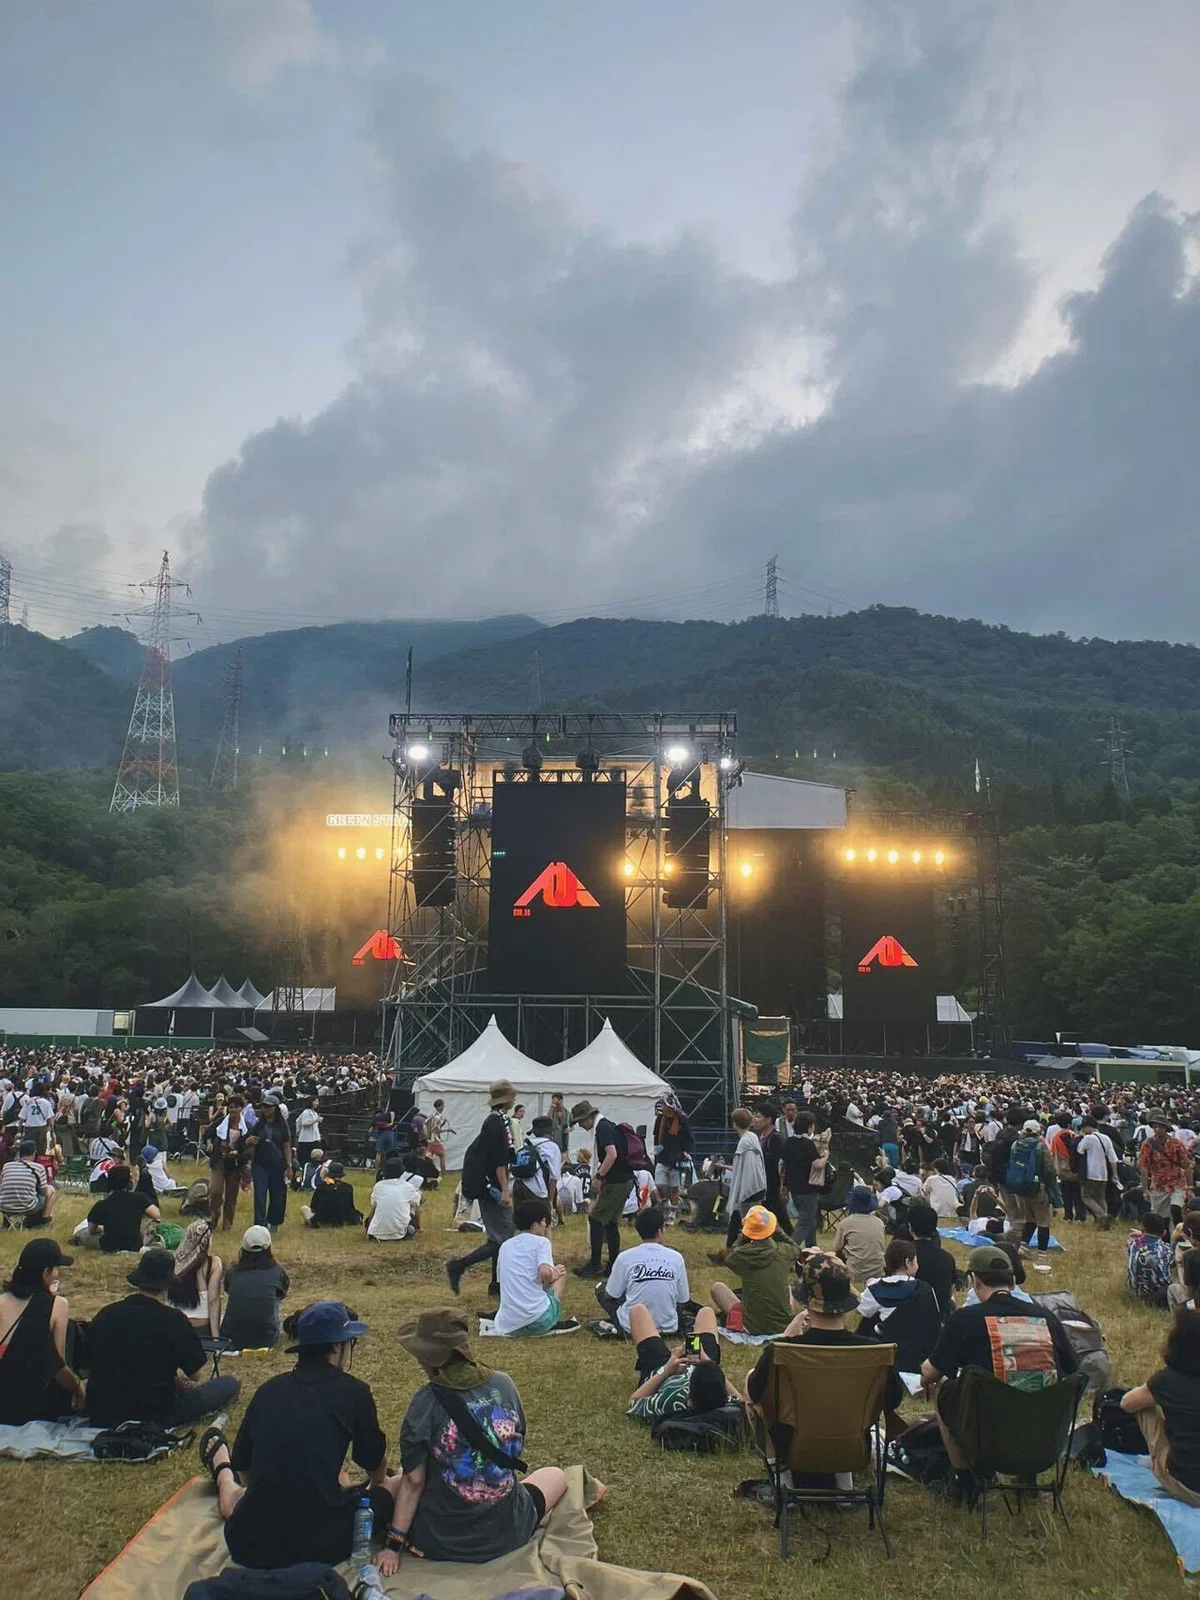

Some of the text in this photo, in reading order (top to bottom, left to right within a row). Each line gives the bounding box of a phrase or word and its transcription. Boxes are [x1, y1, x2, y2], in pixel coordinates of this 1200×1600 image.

[326, 814, 411, 827] GREEN STAG
[631, 1264, 675, 1281] Dickies
